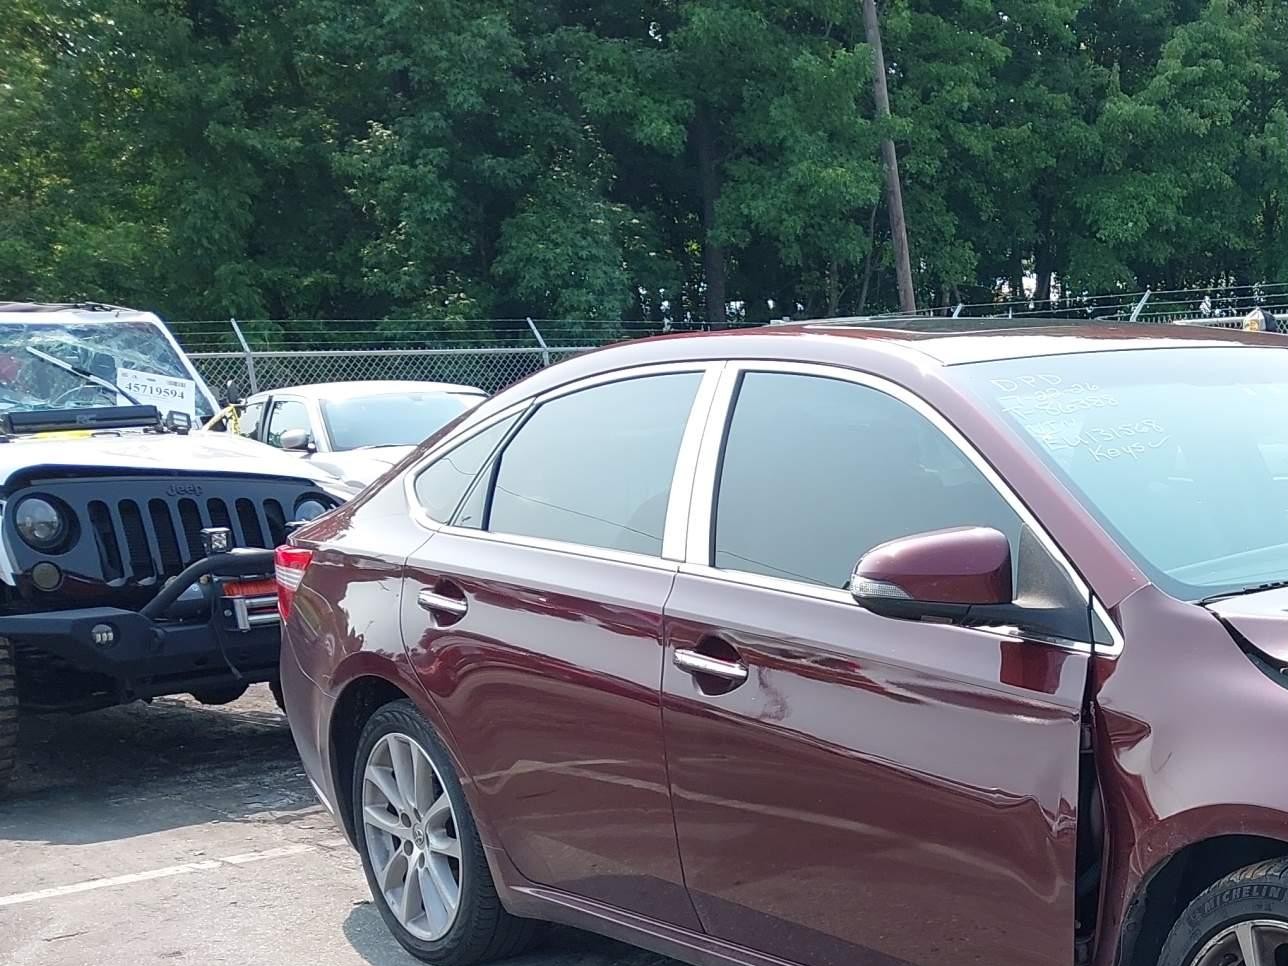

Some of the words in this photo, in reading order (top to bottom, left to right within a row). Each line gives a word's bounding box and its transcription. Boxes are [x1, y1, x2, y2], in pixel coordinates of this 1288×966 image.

[125, 382, 185, 399] 45719594
[990, 373, 1062, 392] DPD
[166, 483, 203, 497] Jeep
[1204, 886, 1283, 913] MICHELIN
